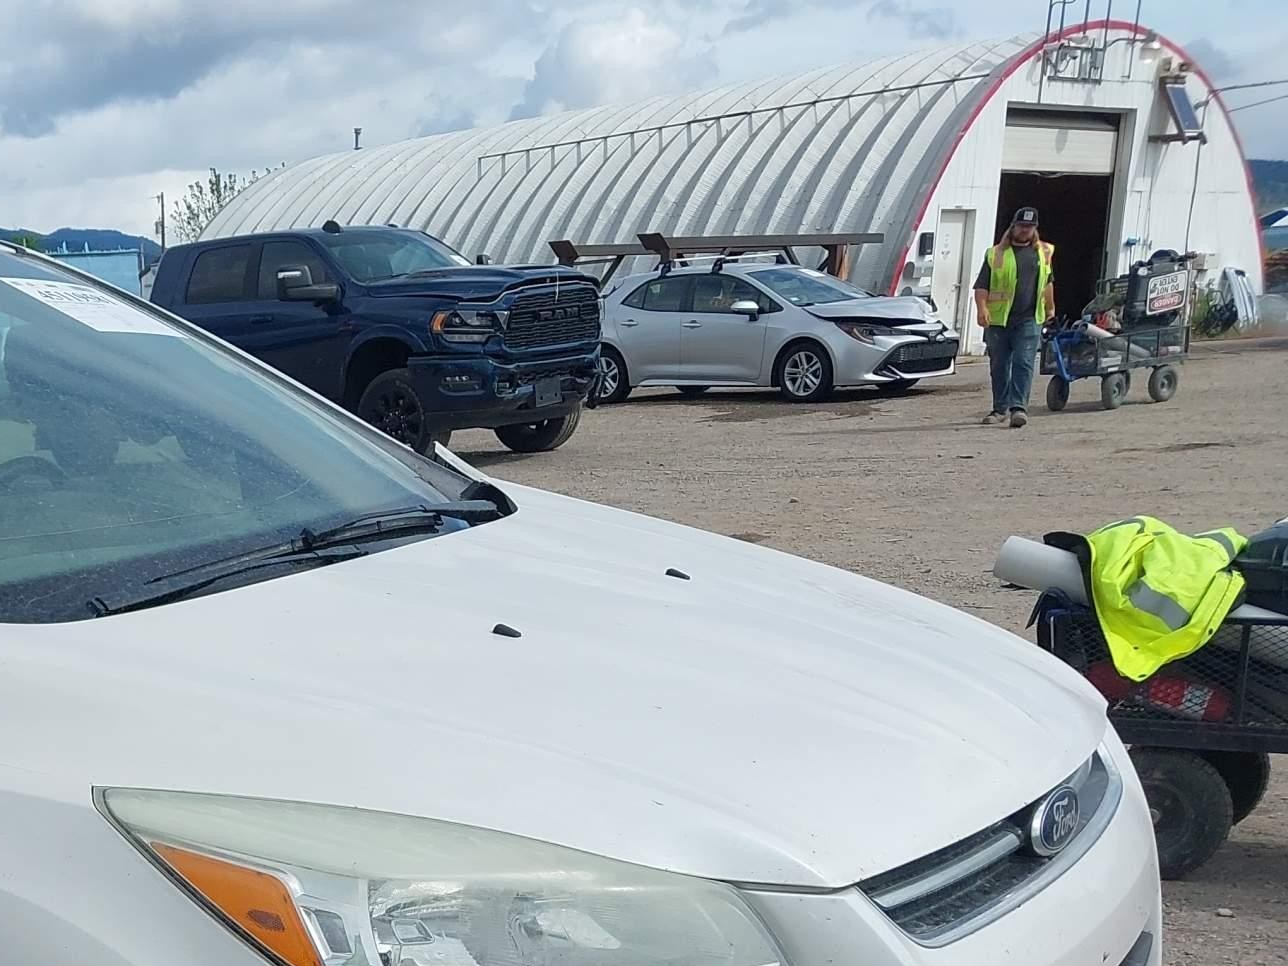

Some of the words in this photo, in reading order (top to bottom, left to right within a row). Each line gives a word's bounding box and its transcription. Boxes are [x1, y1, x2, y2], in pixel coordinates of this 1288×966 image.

[1159, 276, 1178, 286] ENTER
[1171, 283, 1179, 292] DO
[1154, 296, 1179, 307] DANGER
[537, 306, 580, 320] RAM
[1052, 797, 1077, 842] Ford
